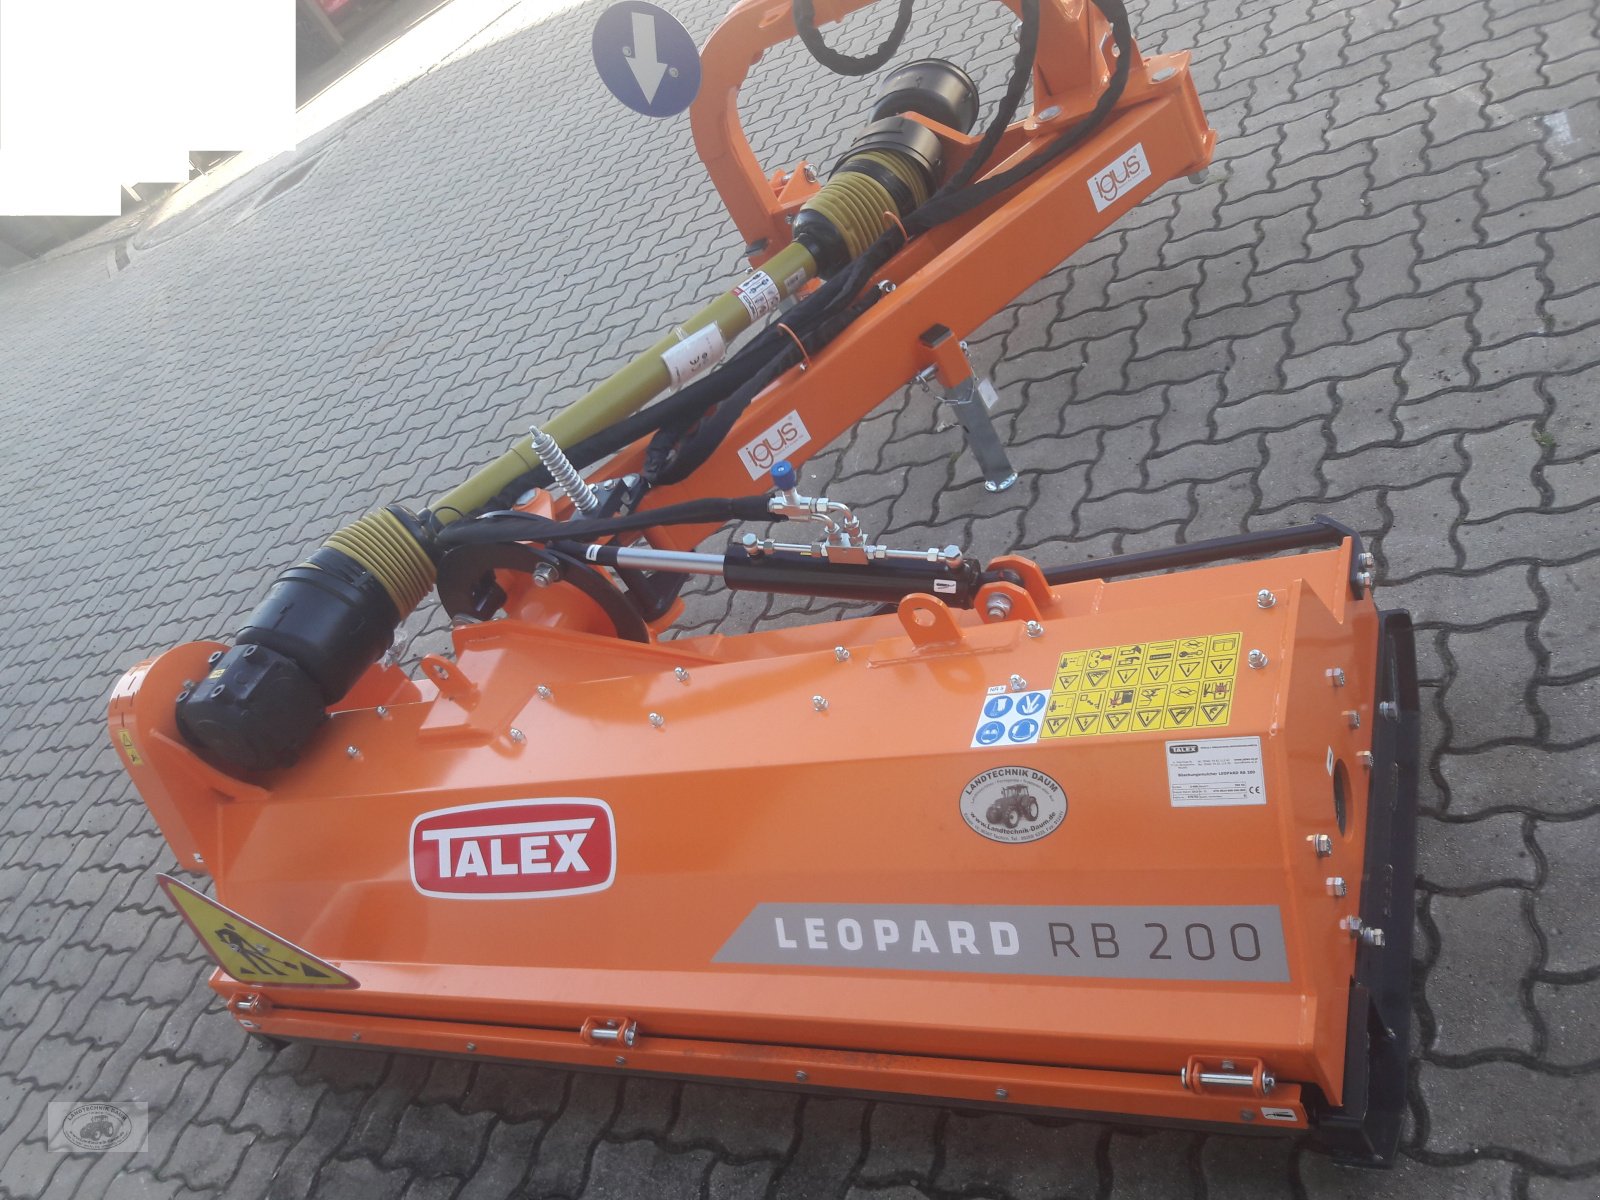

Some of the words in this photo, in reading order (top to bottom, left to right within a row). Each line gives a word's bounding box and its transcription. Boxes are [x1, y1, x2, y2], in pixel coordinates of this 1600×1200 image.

[1094, 154, 1141, 202] igus
[745, 422, 798, 470] igus
[965, 768, 1029, 796] LANDTECHNIK
[1031, 772, 1058, 793] DAUM
[422, 817, 596, 878] TALEX
[774, 917, 1021, 956] LEOPARD
[1048, 922, 1120, 959] RB
[1143, 922, 1262, 961] 200
